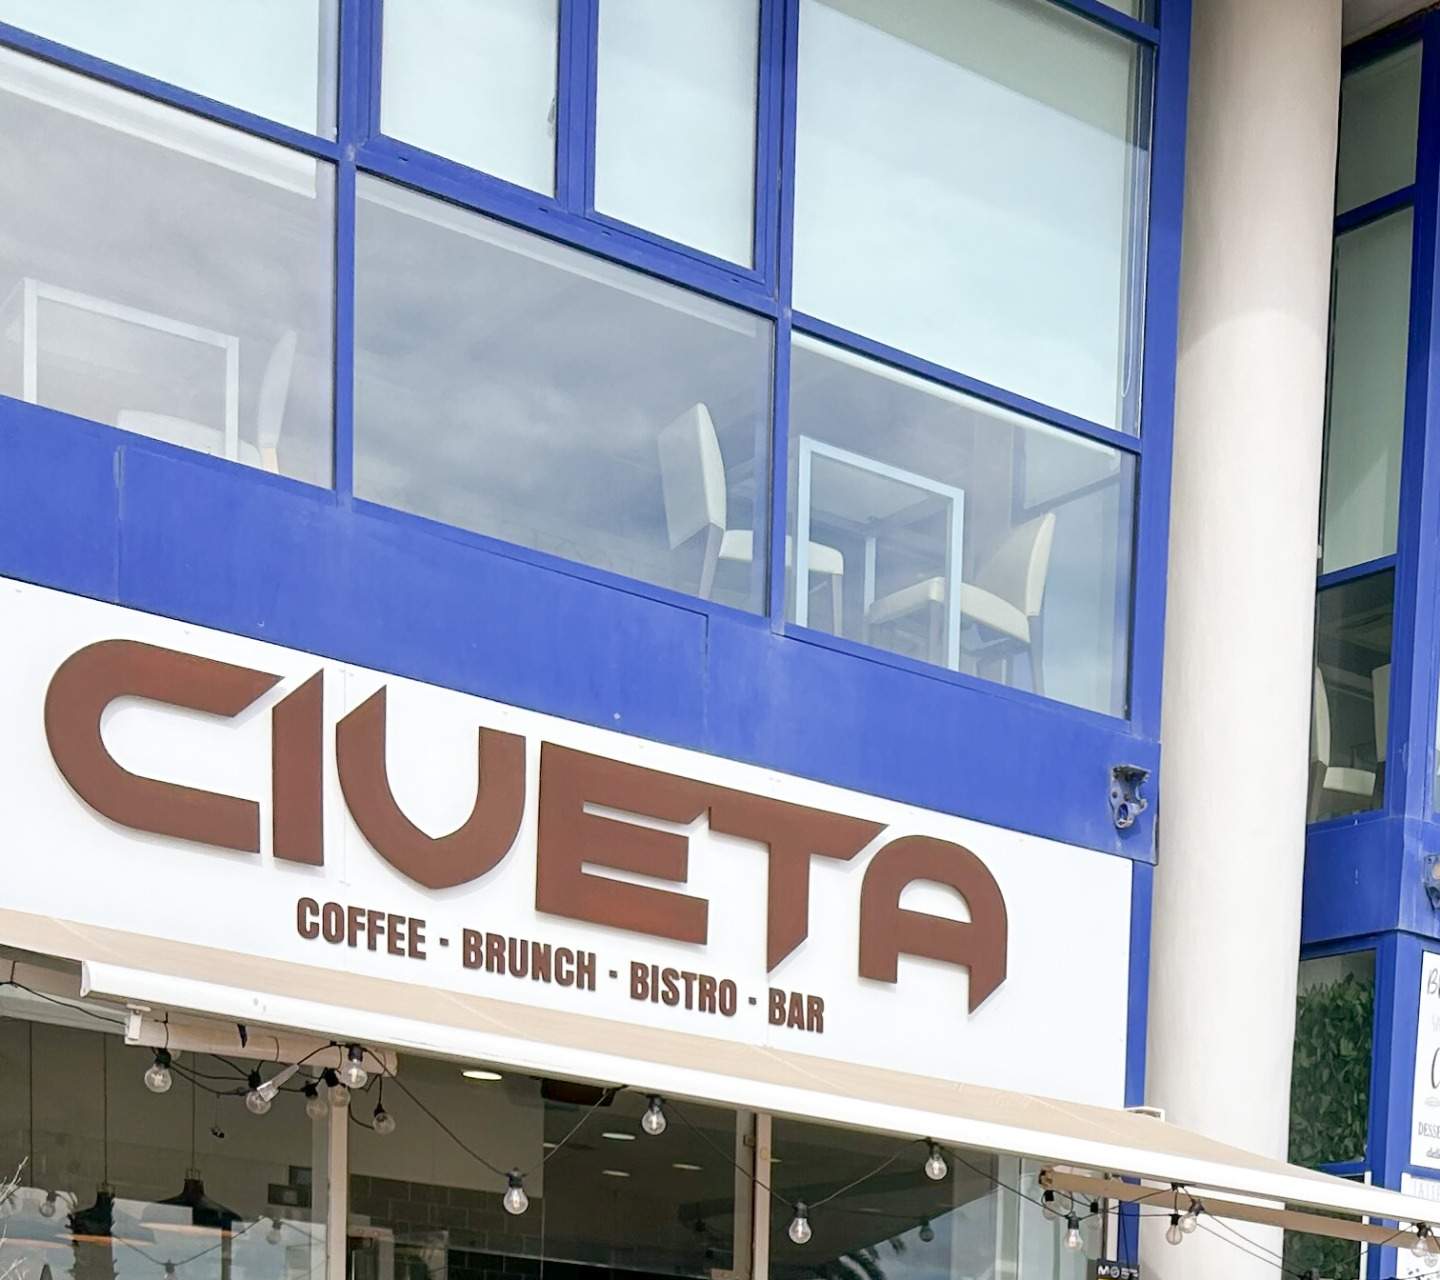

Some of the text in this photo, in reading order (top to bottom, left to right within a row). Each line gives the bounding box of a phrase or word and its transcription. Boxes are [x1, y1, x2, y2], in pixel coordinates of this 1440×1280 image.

[44, 638, 1008, 1014] CIVETA
[296, 897, 825, 1034] COFFEE BRUNCH BISTRO BAR
